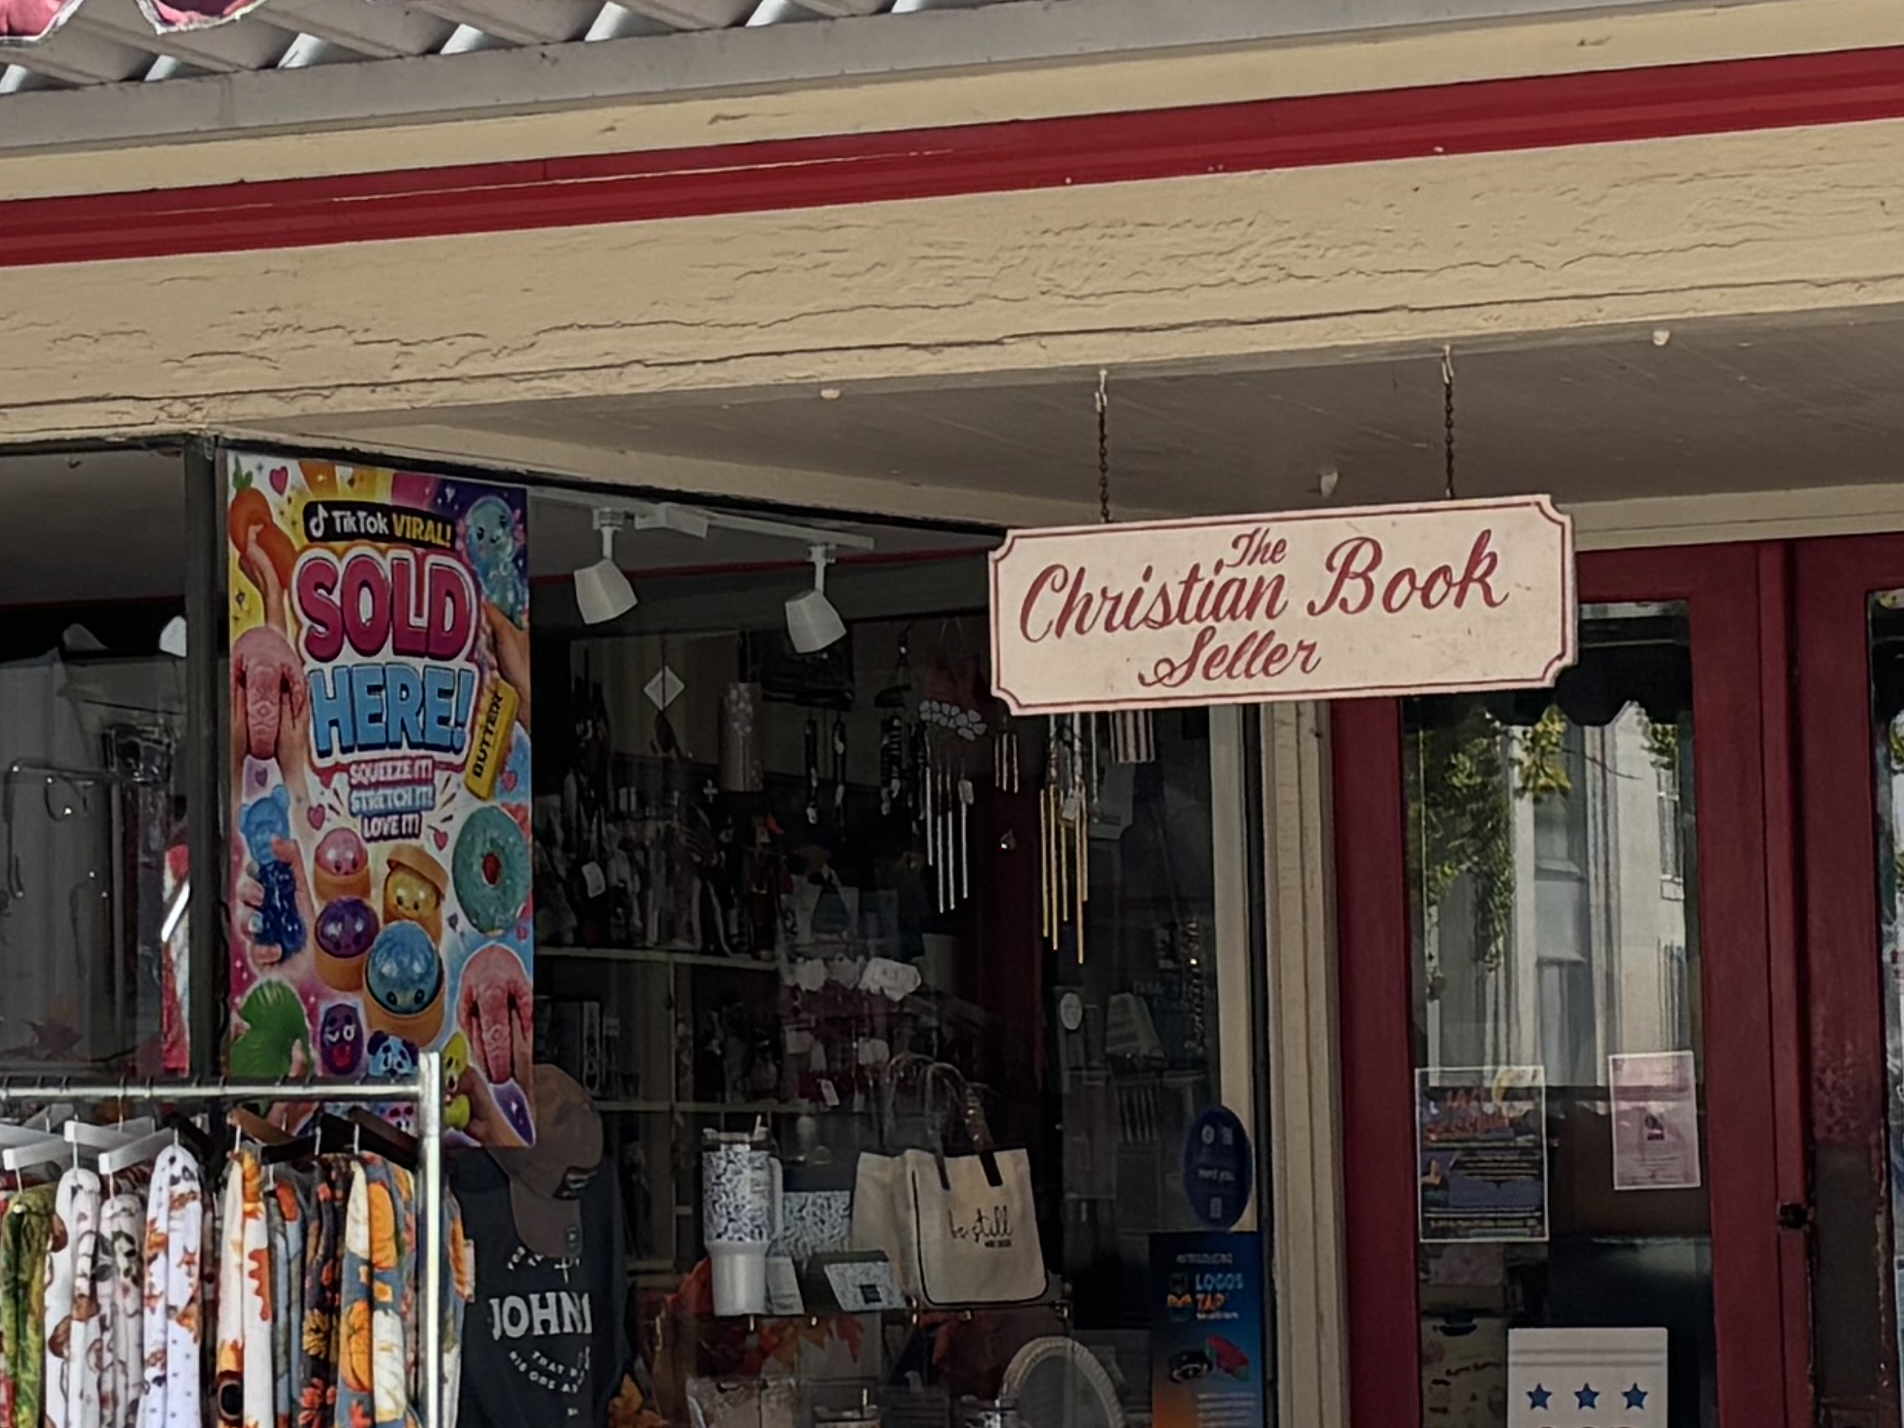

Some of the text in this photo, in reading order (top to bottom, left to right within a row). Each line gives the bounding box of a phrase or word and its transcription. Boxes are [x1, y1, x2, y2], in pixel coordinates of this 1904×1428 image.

[332, 509, 452, 548] TikTok VIRAL!
[1225, 527, 1287, 569] The
[296, 555, 473, 662] SOLD
[1019, 529, 1510, 644] Christian Book
[1137, 626, 1322, 688] Seller
[307, 662, 475, 759] HERE!
[363, 816, 400, 838] LOVE
[947, 1204, 1014, 1245] be still
[1195, 1273, 1244, 1291] LOGOS
[488, 1290, 593, 1341] JOHN
